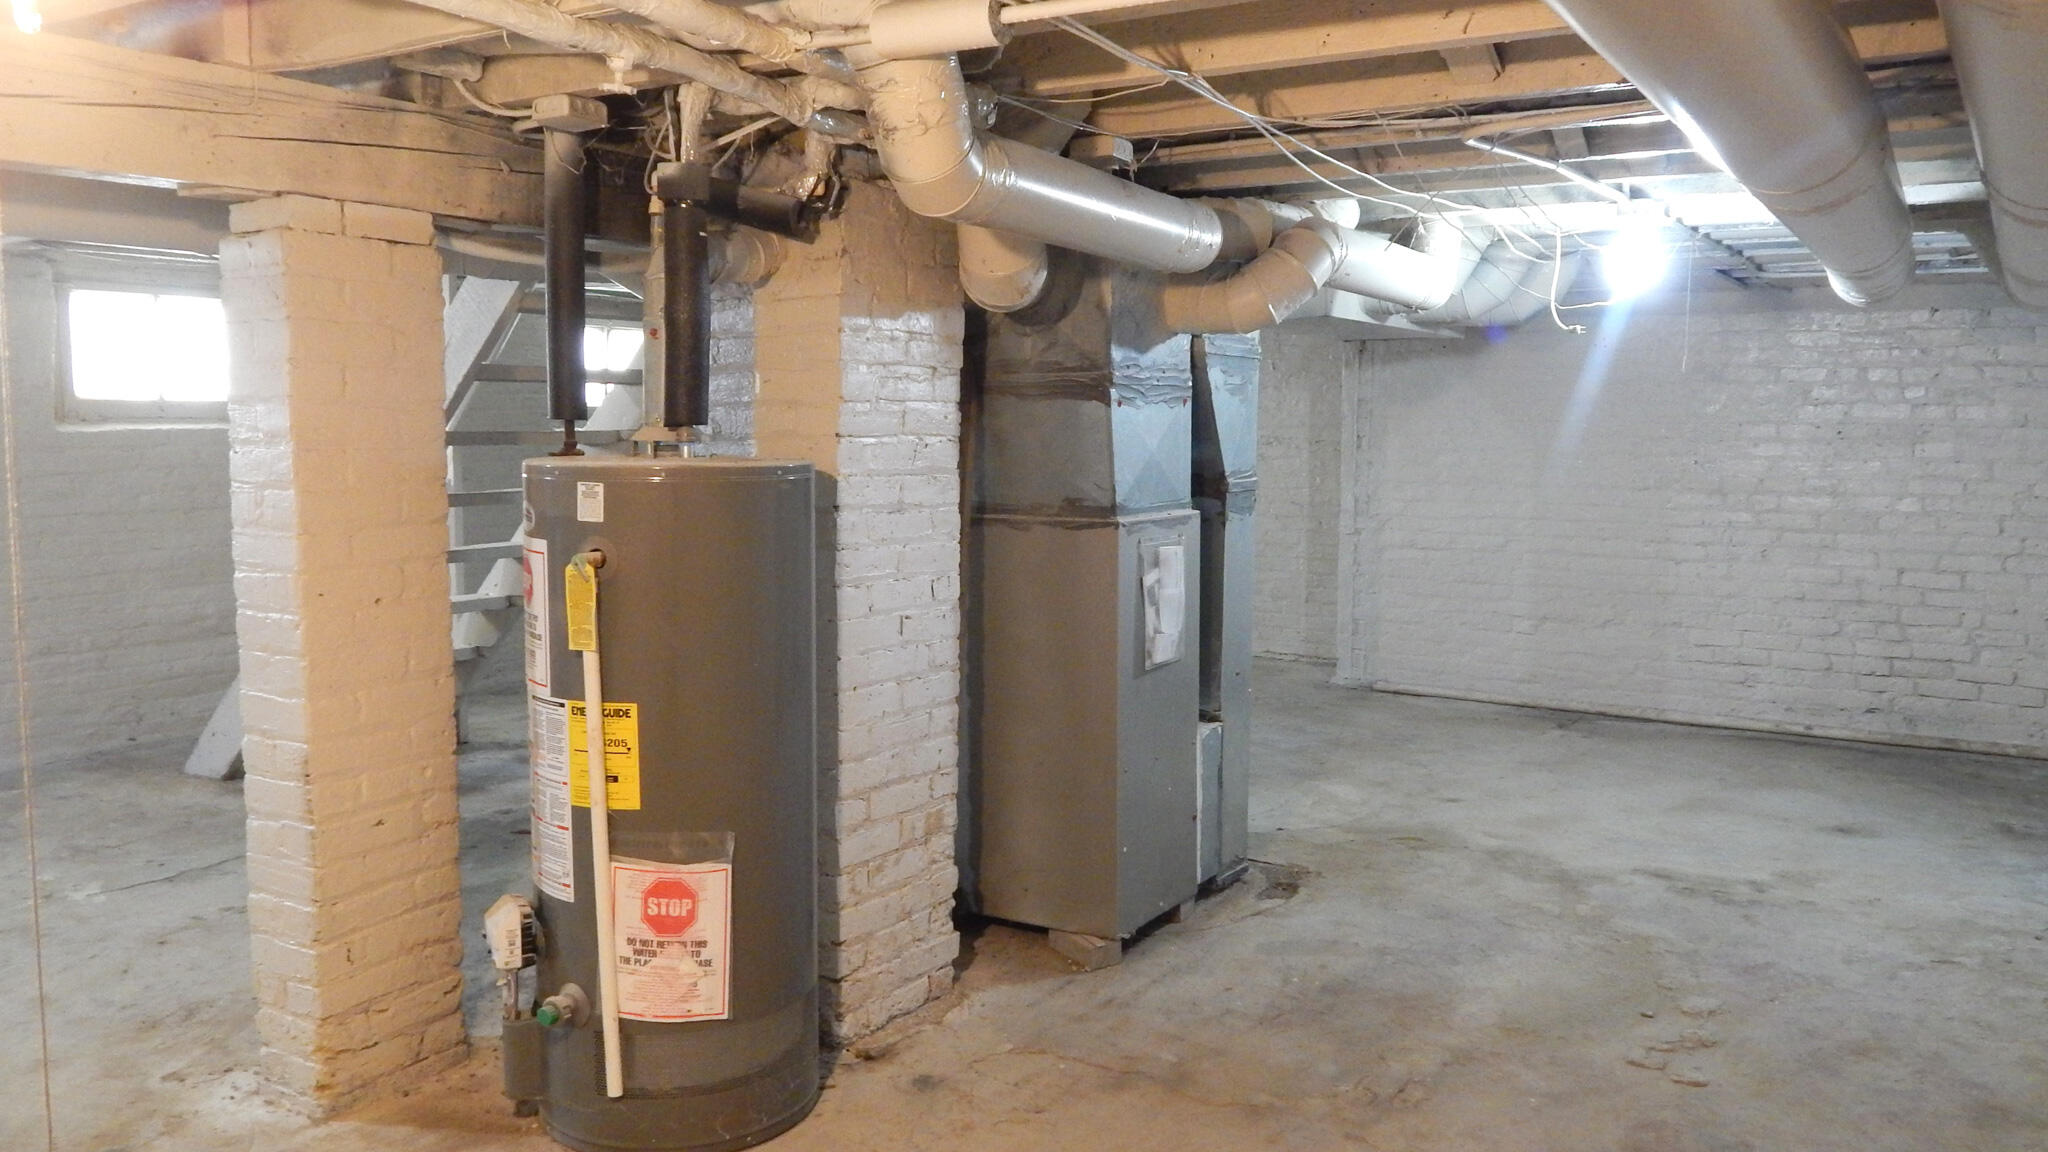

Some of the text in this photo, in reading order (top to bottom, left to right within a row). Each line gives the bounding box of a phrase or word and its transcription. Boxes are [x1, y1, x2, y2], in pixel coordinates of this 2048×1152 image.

[647, 897, 693, 917] STOP
[626, 937, 637, 946] DO
[639, 939, 654, 948] NOT
[691, 940, 708, 949] THIS
[633, 947, 658, 958] WATER
[691, 950, 701, 958] TO
[619, 956, 631, 966] THE
